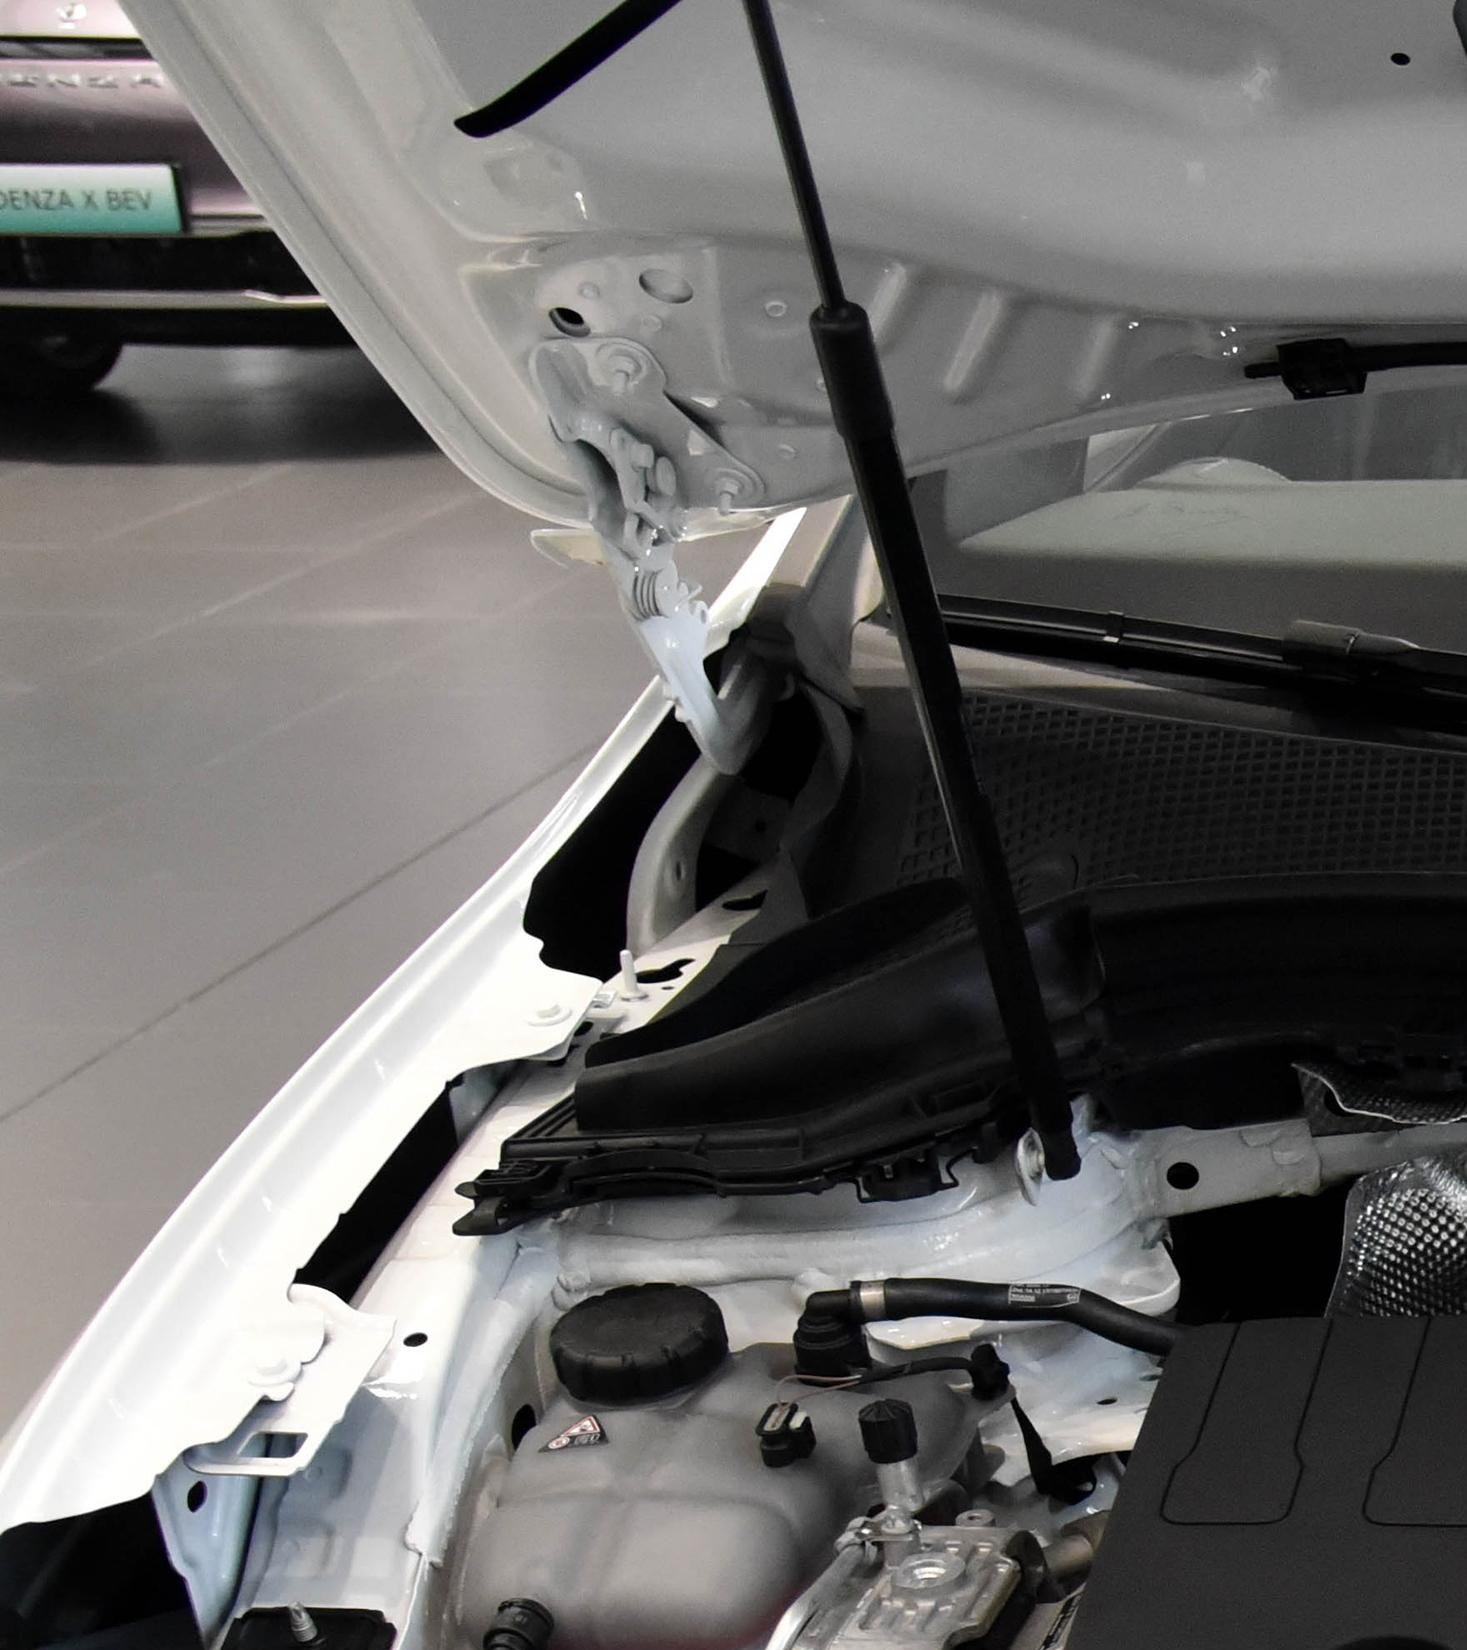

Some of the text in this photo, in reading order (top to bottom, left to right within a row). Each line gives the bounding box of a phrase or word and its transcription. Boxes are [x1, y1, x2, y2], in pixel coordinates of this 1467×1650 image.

[0, 73, 163, 88] ENZA
[81, 189, 98, 210] X
[106, 189, 151, 211] BEV
